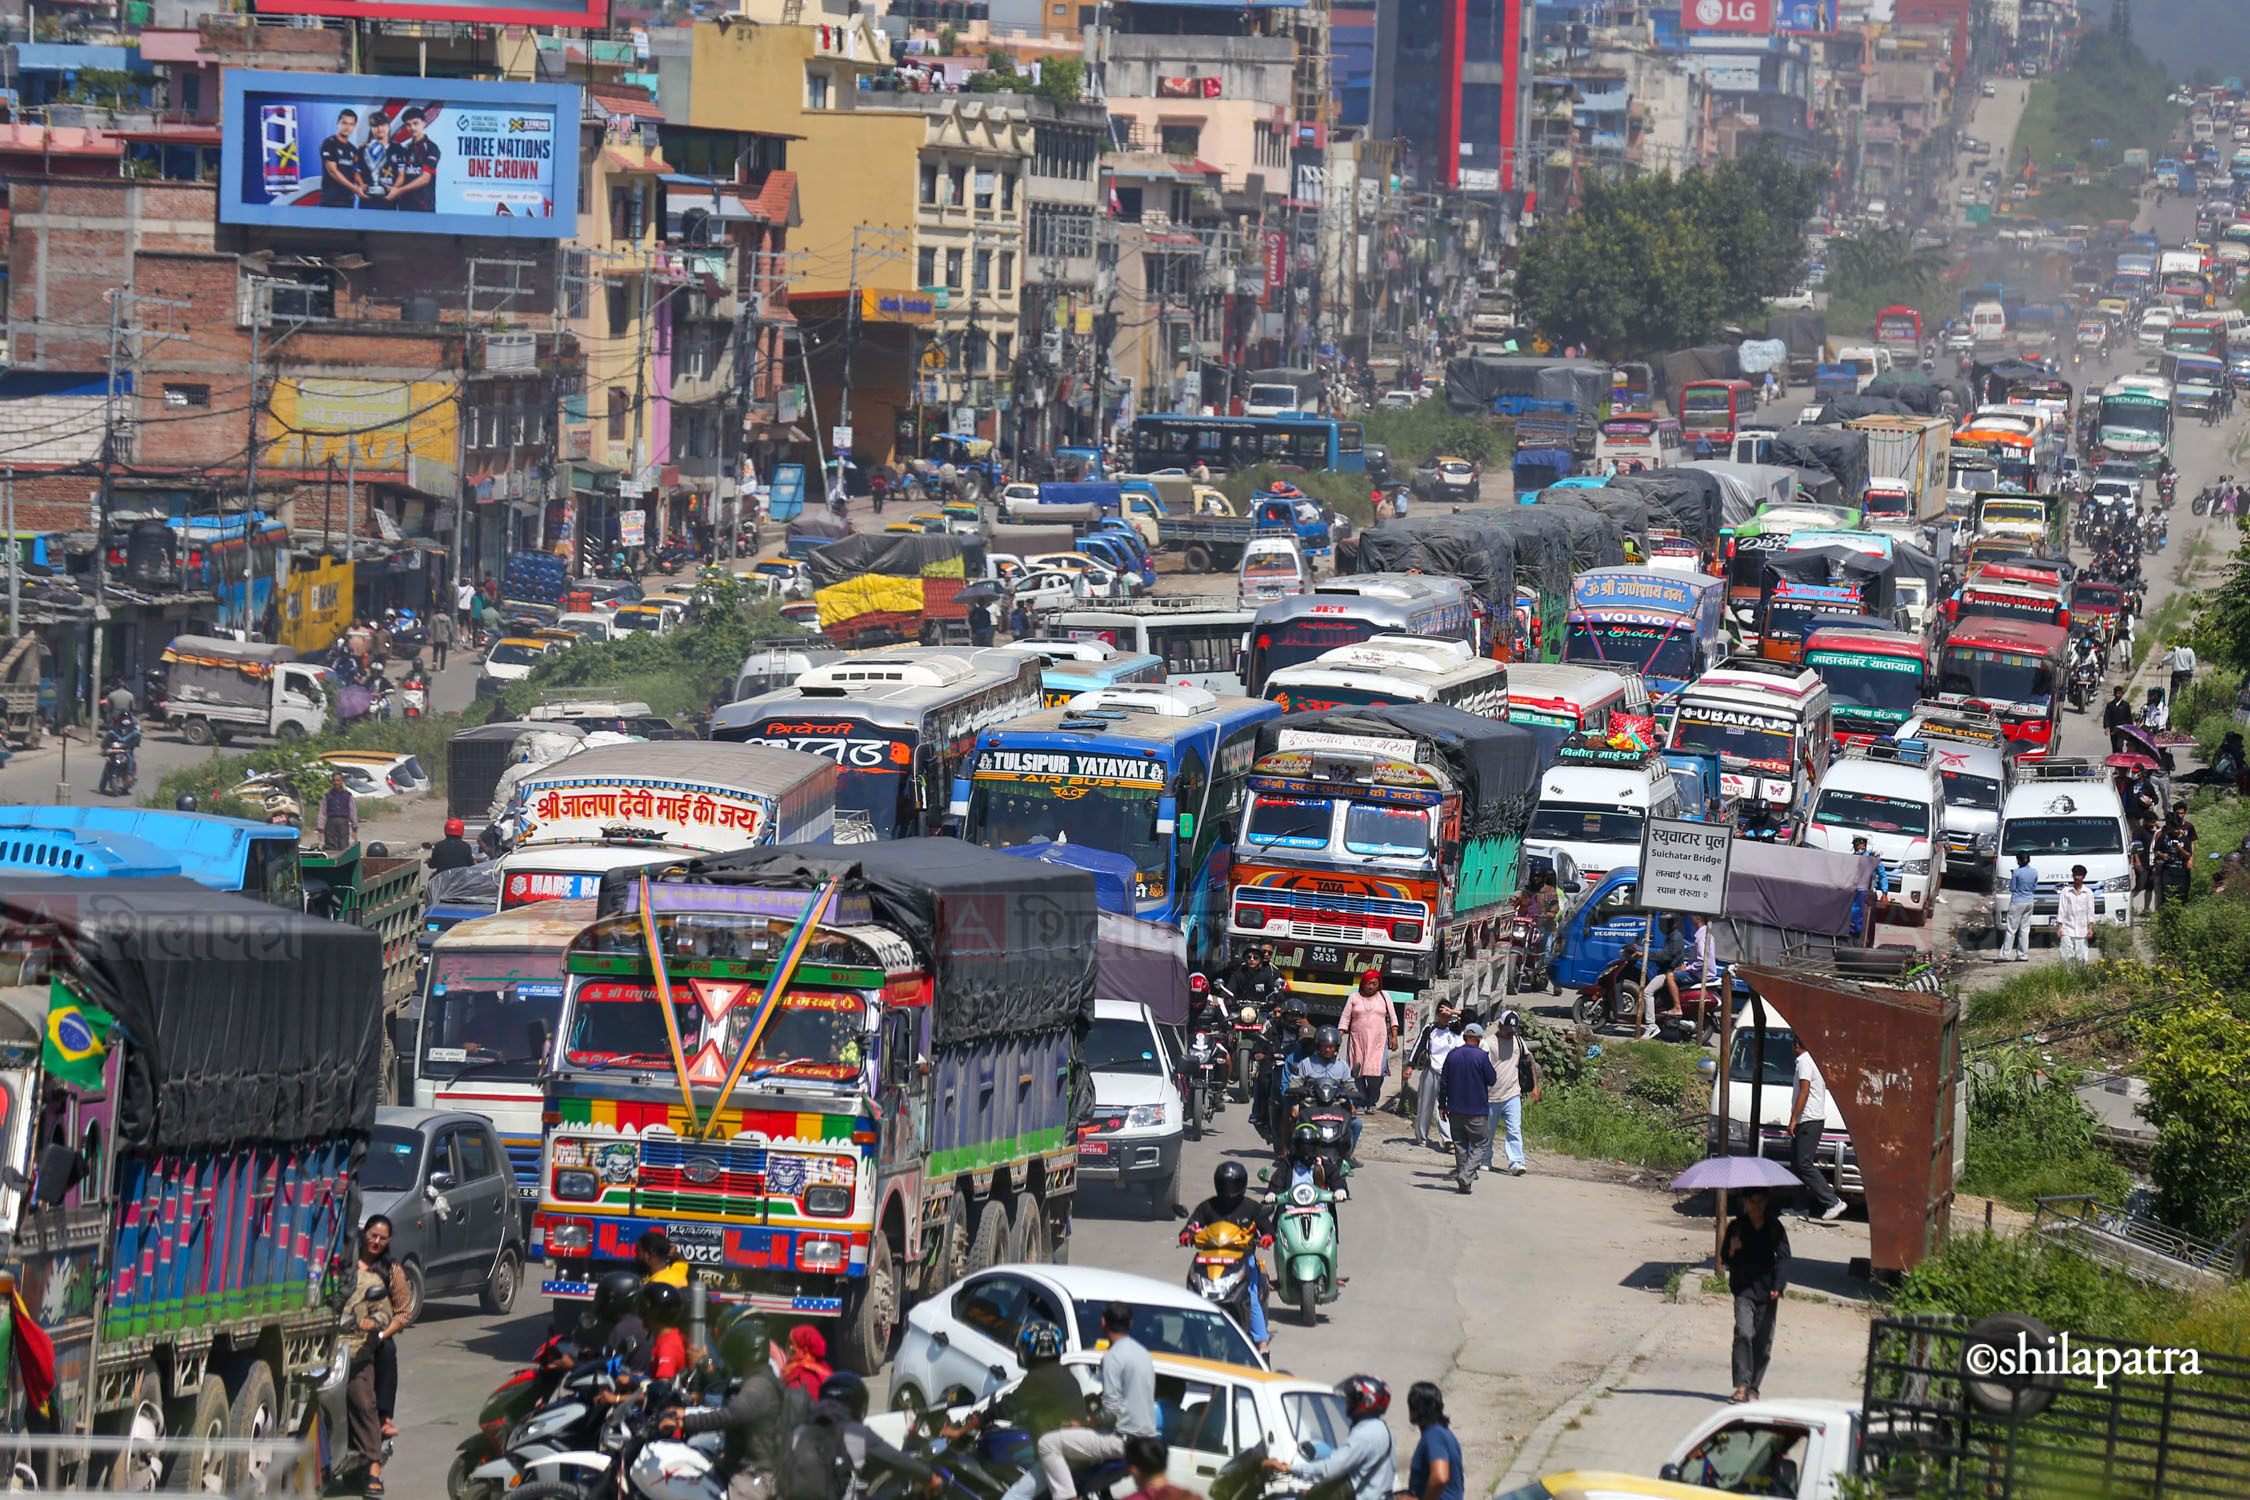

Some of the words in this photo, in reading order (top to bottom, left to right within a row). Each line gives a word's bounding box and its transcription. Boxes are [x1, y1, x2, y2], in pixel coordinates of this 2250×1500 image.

[1727, 3, 1756, 21] LG
[457, 136, 495, 156] THREE
[497, 138, 550, 159] NATIONS
[468, 157, 492, 178] ONE
[494, 159, 538, 179] CROWN
[1601, 580, 1616, 596] श्री
[1617, 580, 1663, 599] गणेशाय
[1664, 586, 1687, 603] नमः
[1974, 600, 2010, 608] METRO
[2014, 604, 2055, 614] DELUXE
[1975, 592, 2057, 608] GODAWARI
[1600, 612, 1666, 625] VOLVO
[1870, 659, 1916, 674] यातायात
[994, 751, 1070, 774] TULSIPUR
[1076, 756, 1149, 779] YATAYAT
[1021, 774, 1063, 784] AIR
[1068, 776, 1116, 787] BUS
[1060, 788, 1078, 797] A.C
[1369, 786, 1388, 798] की
[1389, 791, 1412, 800] जय
[537, 790, 561, 820] श्री
[561, 793, 617, 820] जालपा
[618, 788, 655, 821] देवी
[656, 794, 693, 826] माई
[692, 795, 718, 826] की
[717, 803, 758, 835] जय
[1652, 828, 1702, 846] स्युचाटार
[1705, 835, 1726, 851] पुल
[1651, 848, 1692, 861] Suichatar
[1693, 853, 1722, 866] Bridge
[1655, 869, 1681, 880] लम्बाई
[531, 874, 573, 898] HARE
[1316, 881, 1345, 893] TATA
[1656, 886, 1676, 895] स्पान
